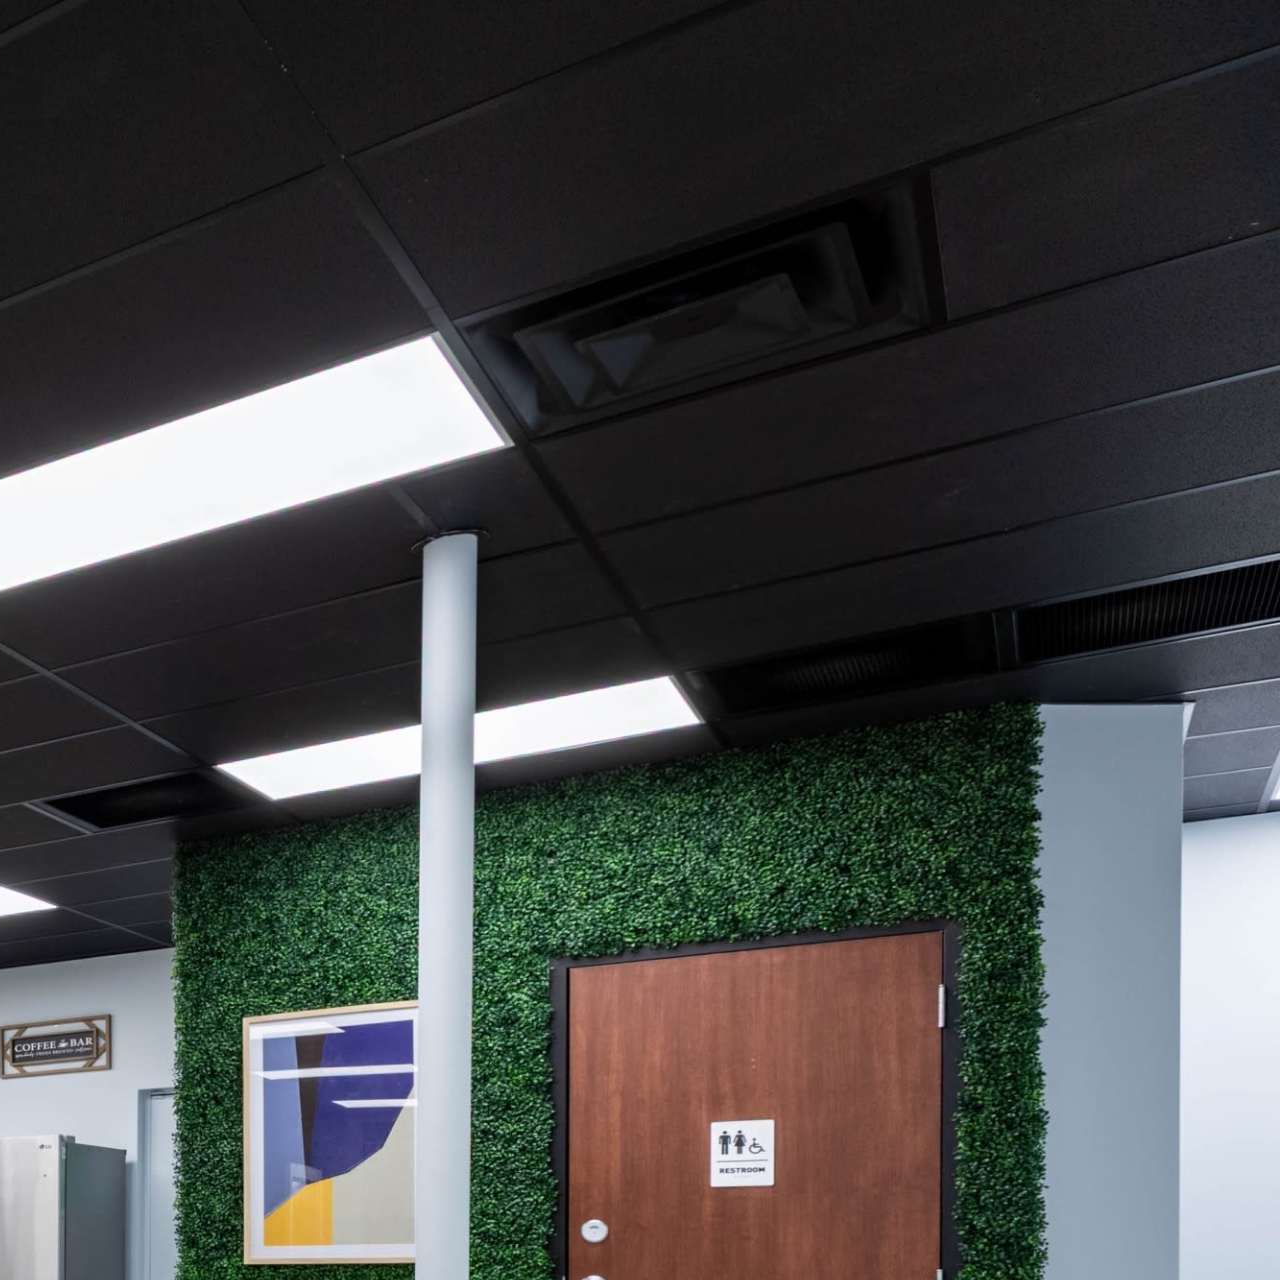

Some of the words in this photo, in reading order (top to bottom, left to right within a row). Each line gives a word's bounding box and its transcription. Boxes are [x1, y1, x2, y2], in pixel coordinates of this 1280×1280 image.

[14, 1040, 56, 1053] COFFEE
[70, 1036, 93, 1047] BAR
[719, 1166, 766, 1174] RESTROOM
